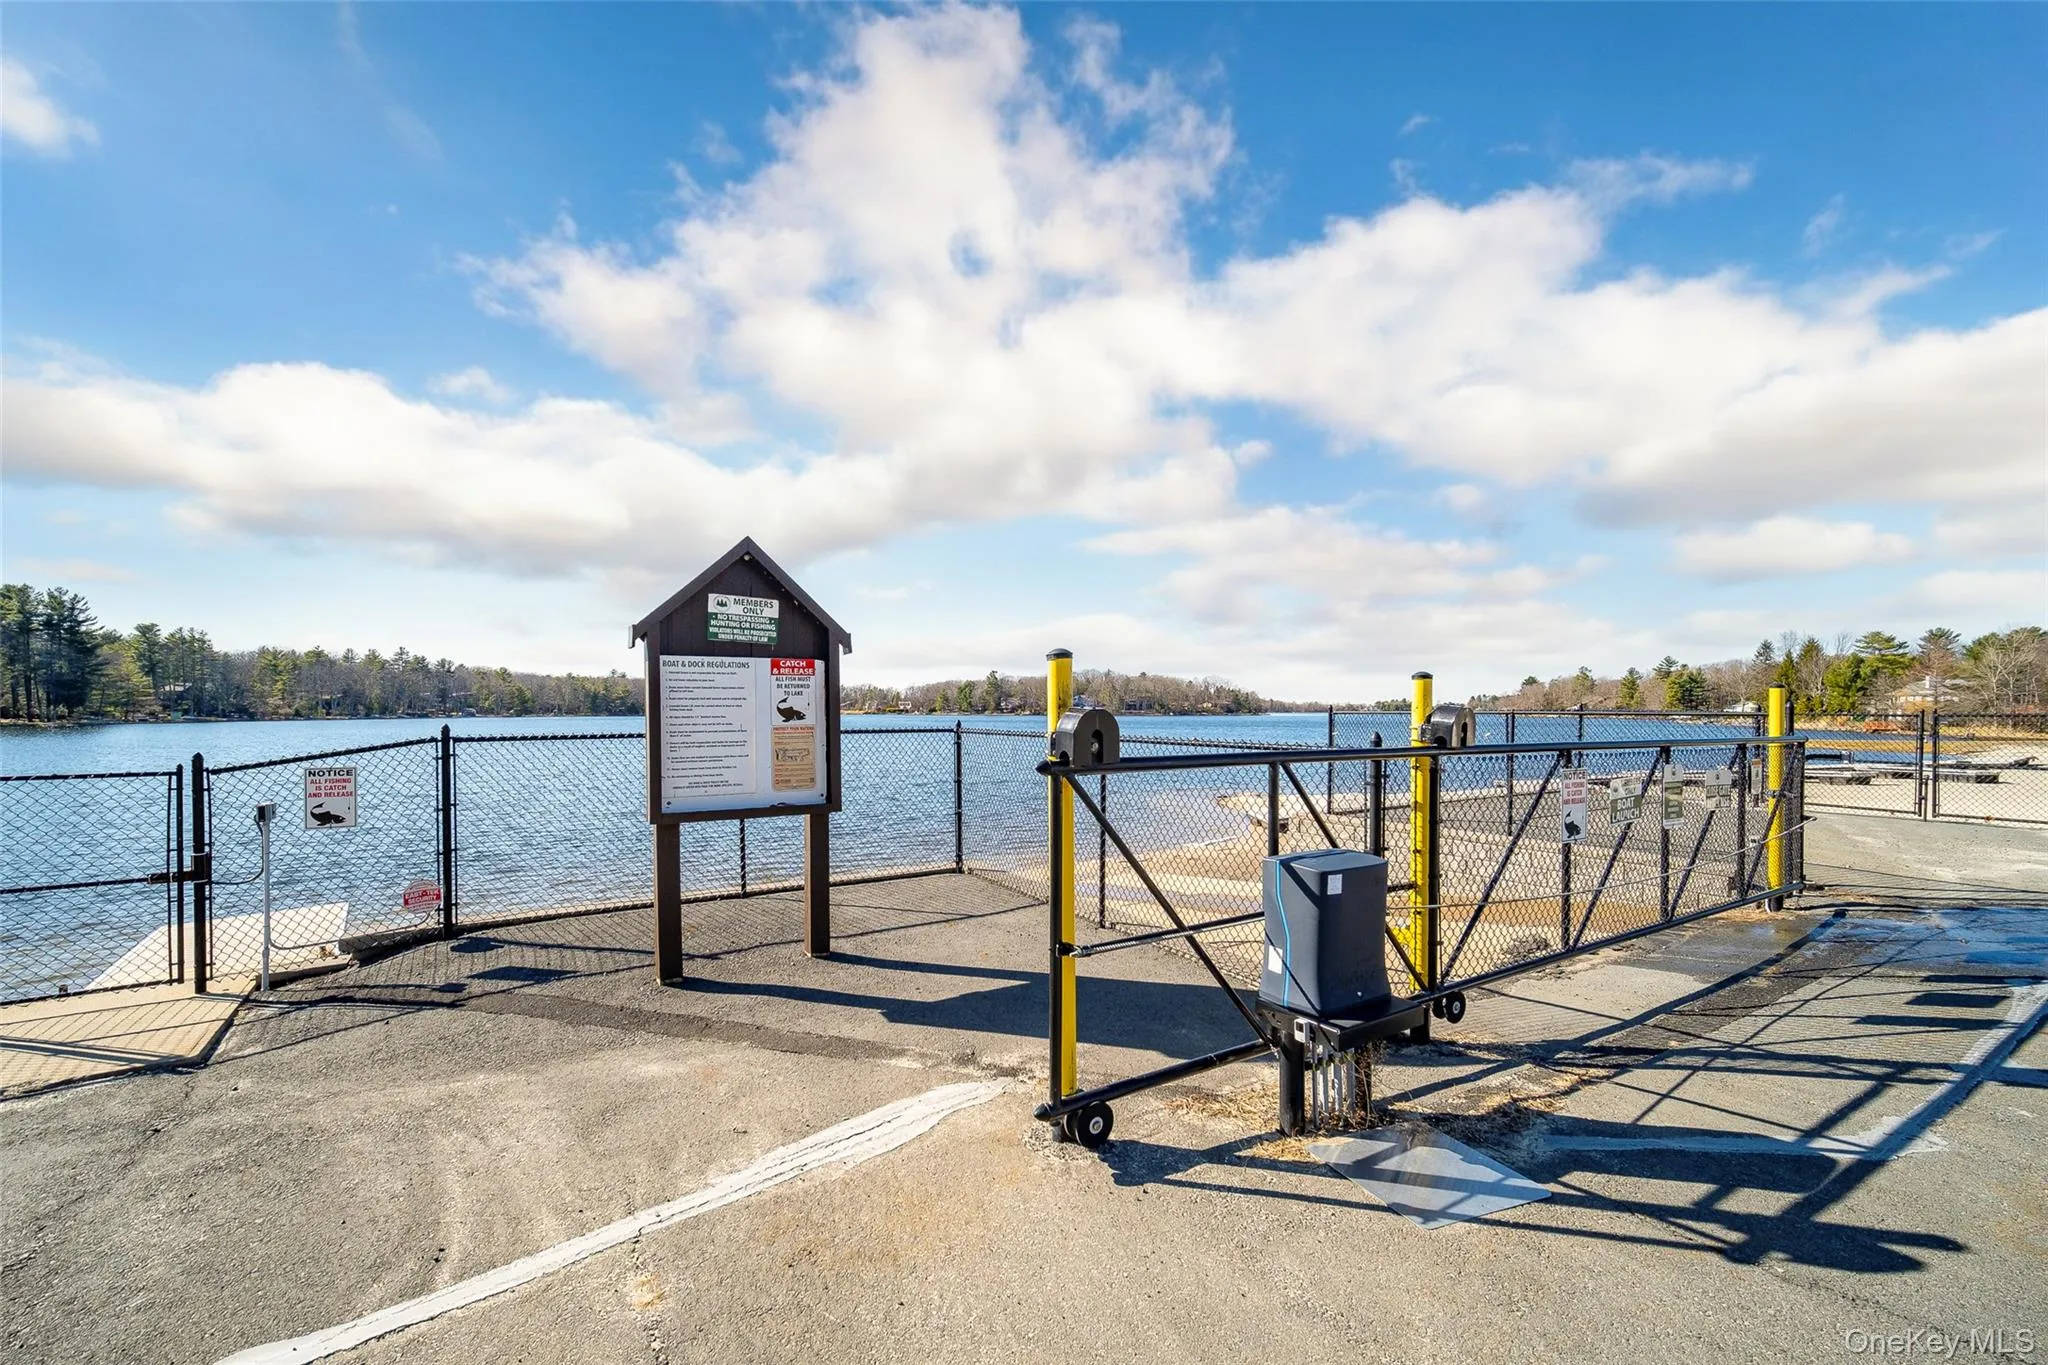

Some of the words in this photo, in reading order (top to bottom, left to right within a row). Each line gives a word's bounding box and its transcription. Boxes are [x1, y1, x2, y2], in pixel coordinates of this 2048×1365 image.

[733, 598, 774, 608] MEMBERS
[742, 606, 764, 615] ONLY
[710, 620, 740, 628] HUNTING
[728, 615, 769, 624] TRESPASSING
[707, 661, 750, 669] REGULATIONS
[1564, 772, 1586, 780] NOTICE
[1617, 797, 1635, 809] BOAT
[1612, 808, 1639, 822] LAUNCH
[405, 888, 440, 899] EAST-TEK
[408, 896, 436, 904] SECURITY
